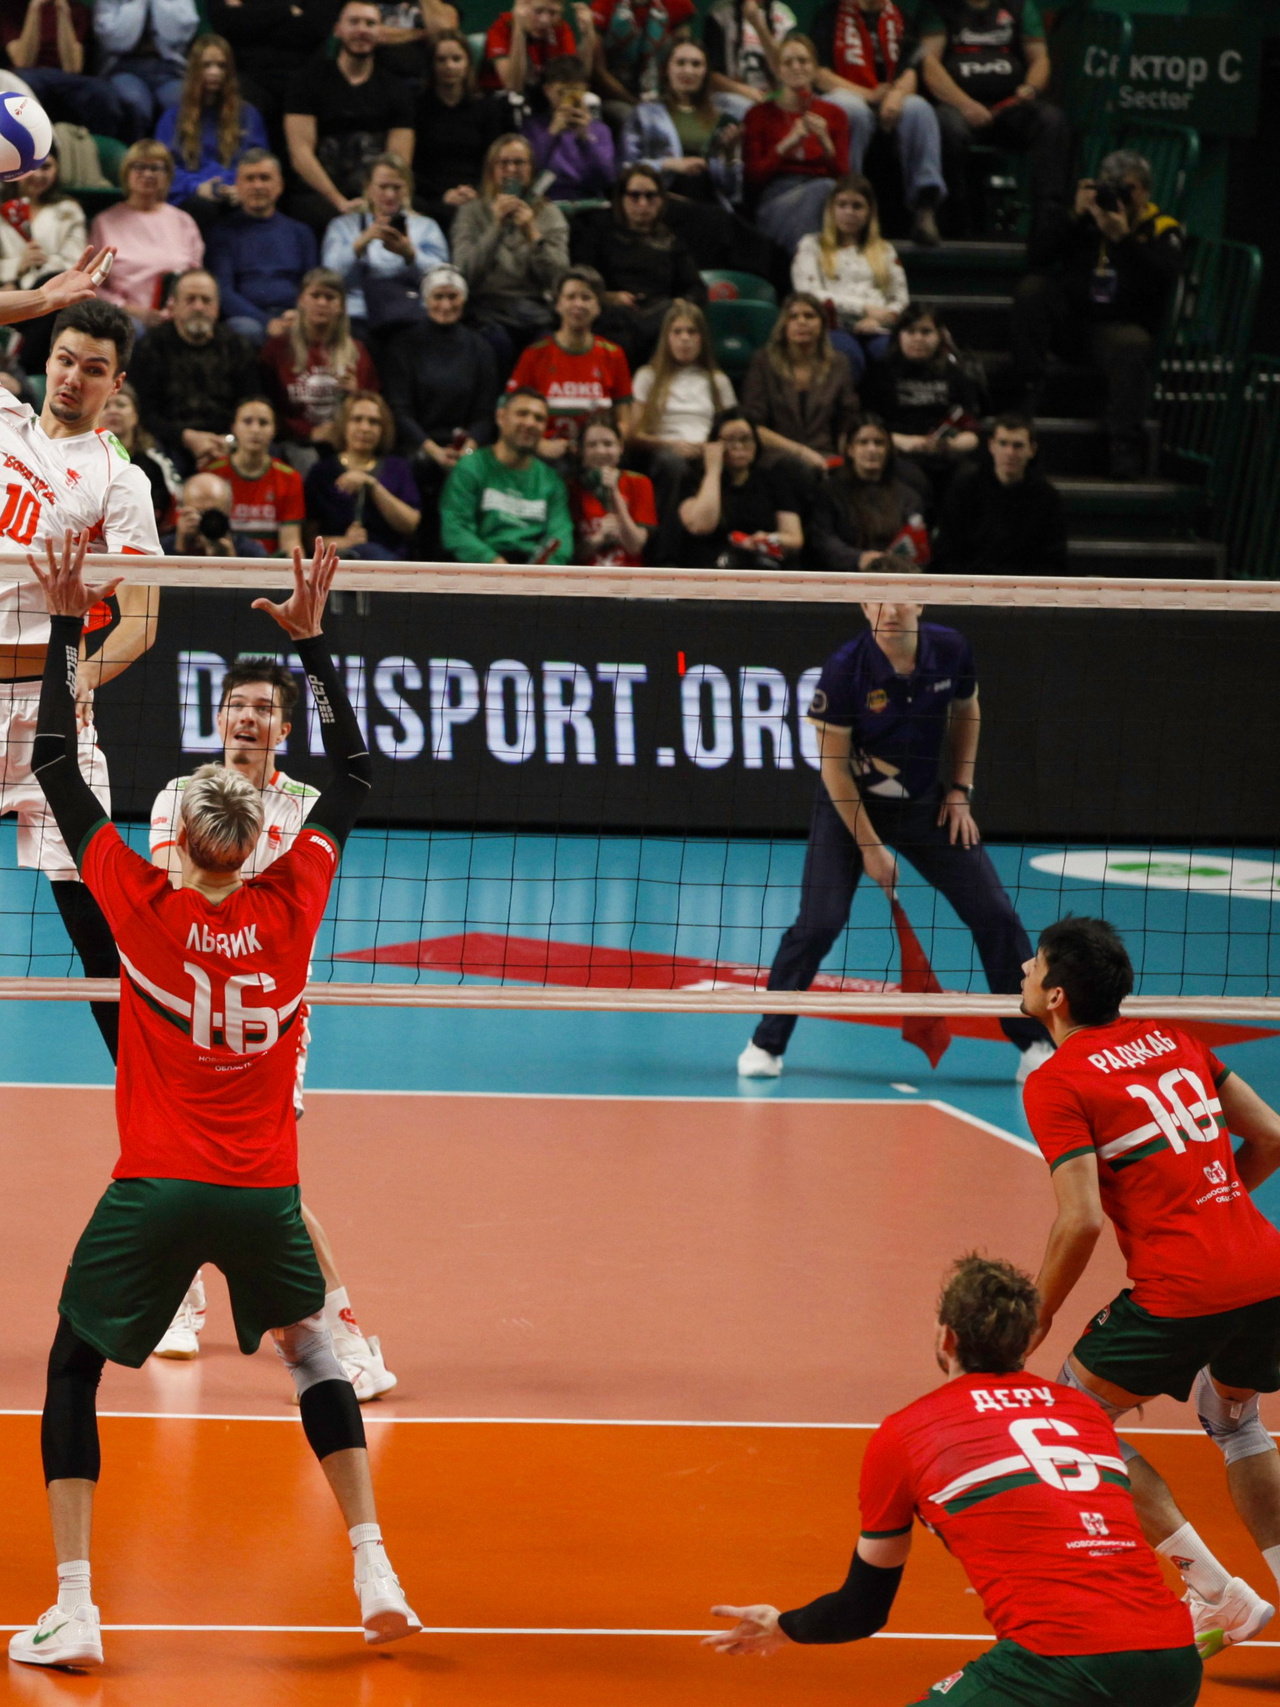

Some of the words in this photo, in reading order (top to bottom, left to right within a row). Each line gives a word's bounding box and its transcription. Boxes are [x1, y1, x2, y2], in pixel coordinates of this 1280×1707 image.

[1119, 85, 1192, 110] Sector
[185, 922, 263, 959] ЛЬВИК
[183, 961, 278, 1054] 16
[1087, 1030, 1177, 1074] РАДЖАБ
[1125, 1067, 1220, 1155] 10
[970, 1387, 1055, 1413] ДЕРУ
[1008, 1417, 1101, 1492] 6
